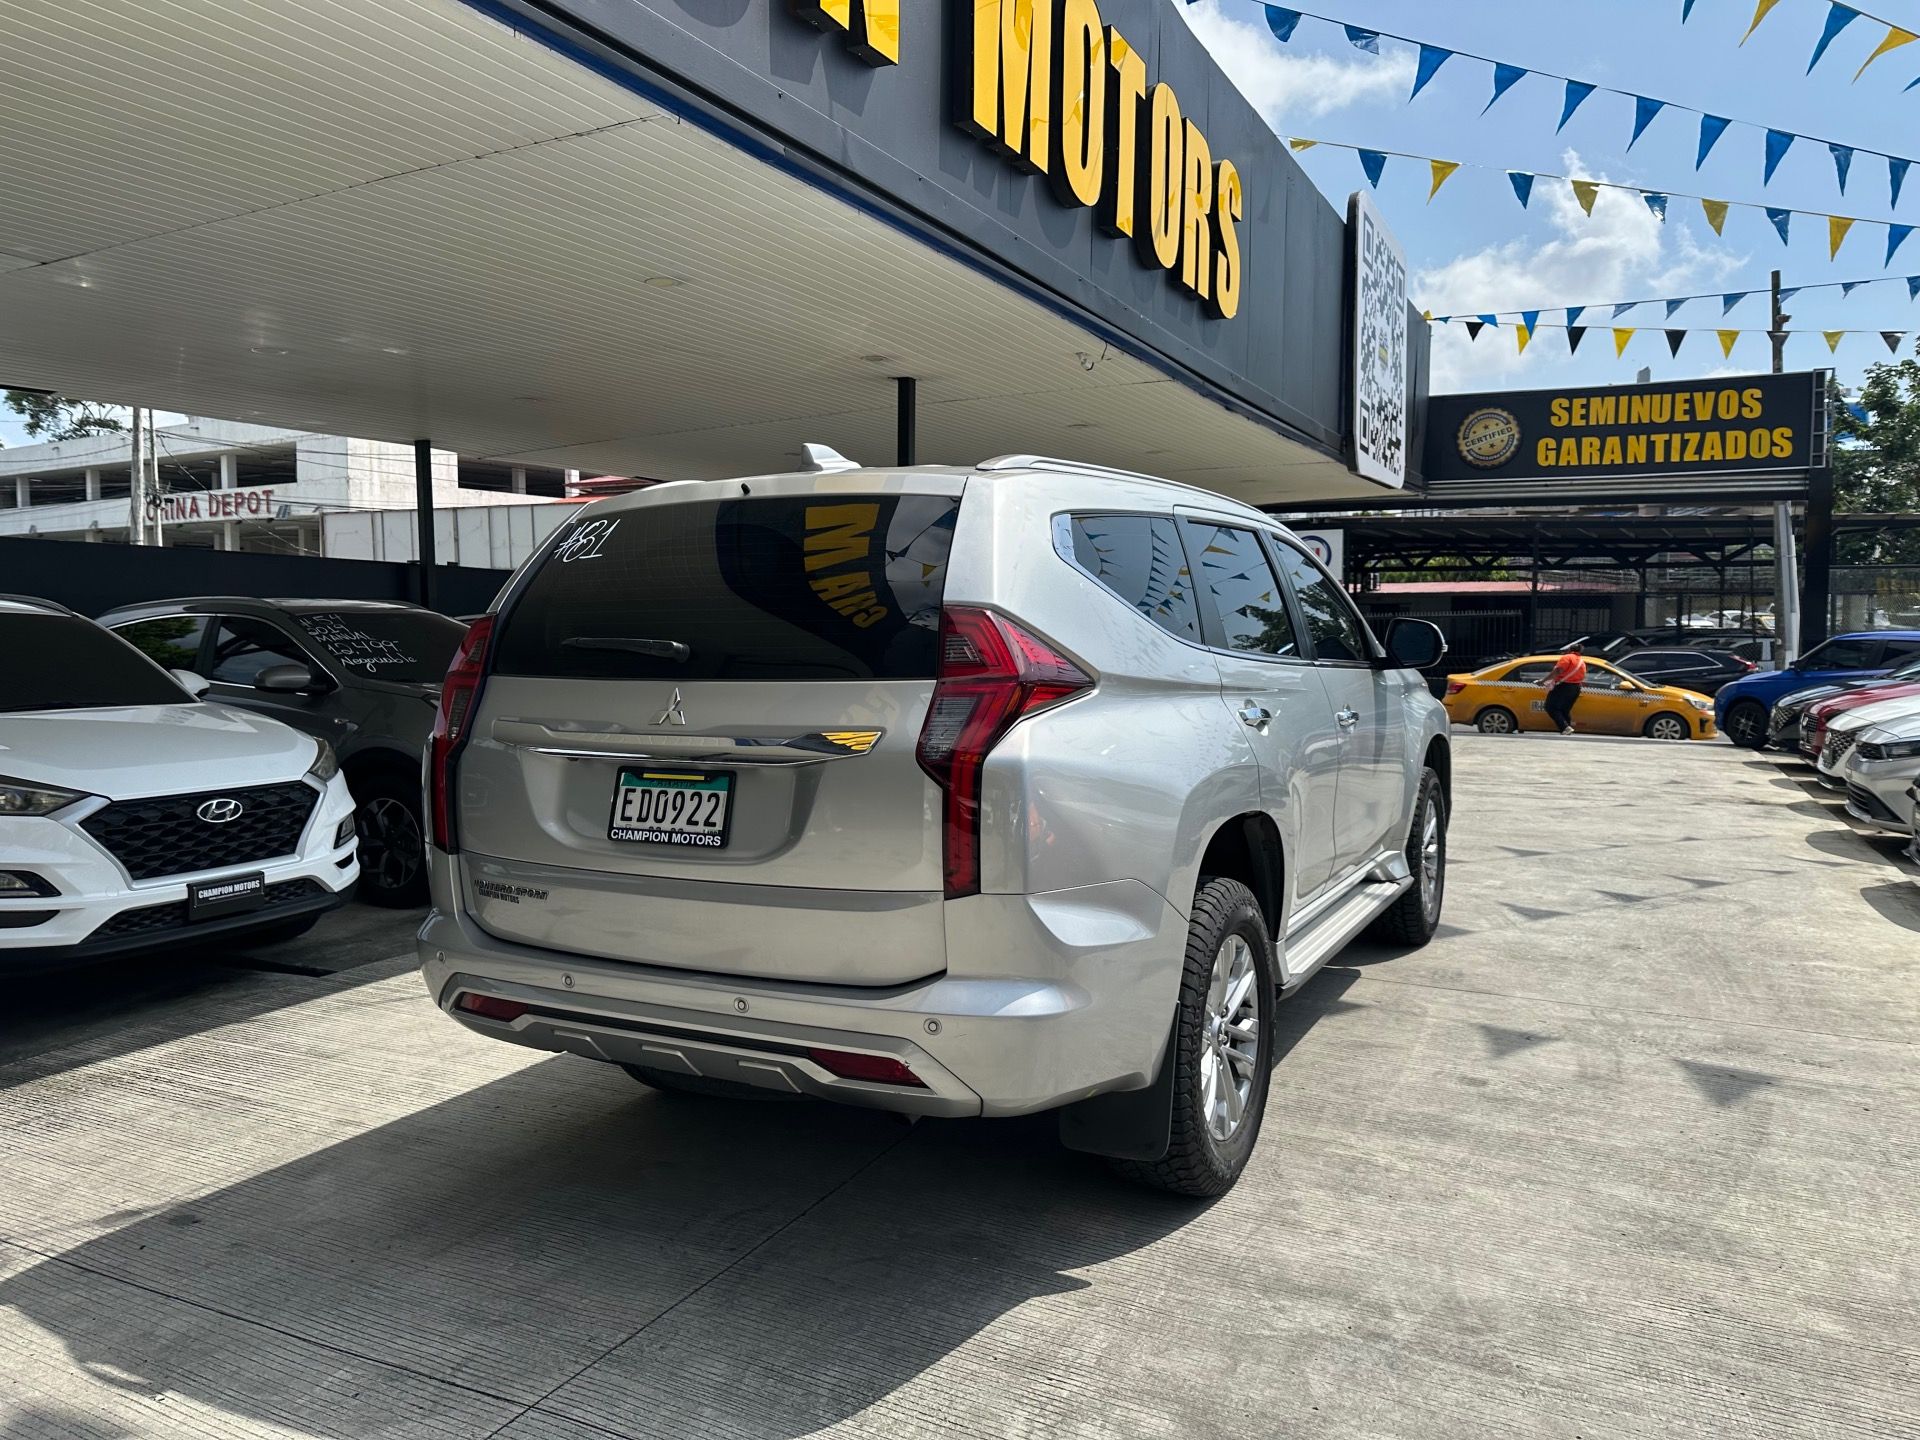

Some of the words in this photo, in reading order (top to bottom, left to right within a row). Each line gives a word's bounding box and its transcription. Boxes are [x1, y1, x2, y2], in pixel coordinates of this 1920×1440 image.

[973, 0, 1243, 319] MOTORS
[1550, 387, 1763, 428] SEMINUEVOS
[1465, 426, 1512, 447] CERTIFIED
[1537, 427, 1793, 467] GARANTIZADOS
[208, 489, 275, 518] DEPOT
[620, 787, 721, 828] ED0922
[610, 828, 669, 843] CHAMPION
[671, 833, 721, 847] MOTORS
[198, 884, 233, 899] CHAMPION
[233, 880, 260, 893] MOTORS
